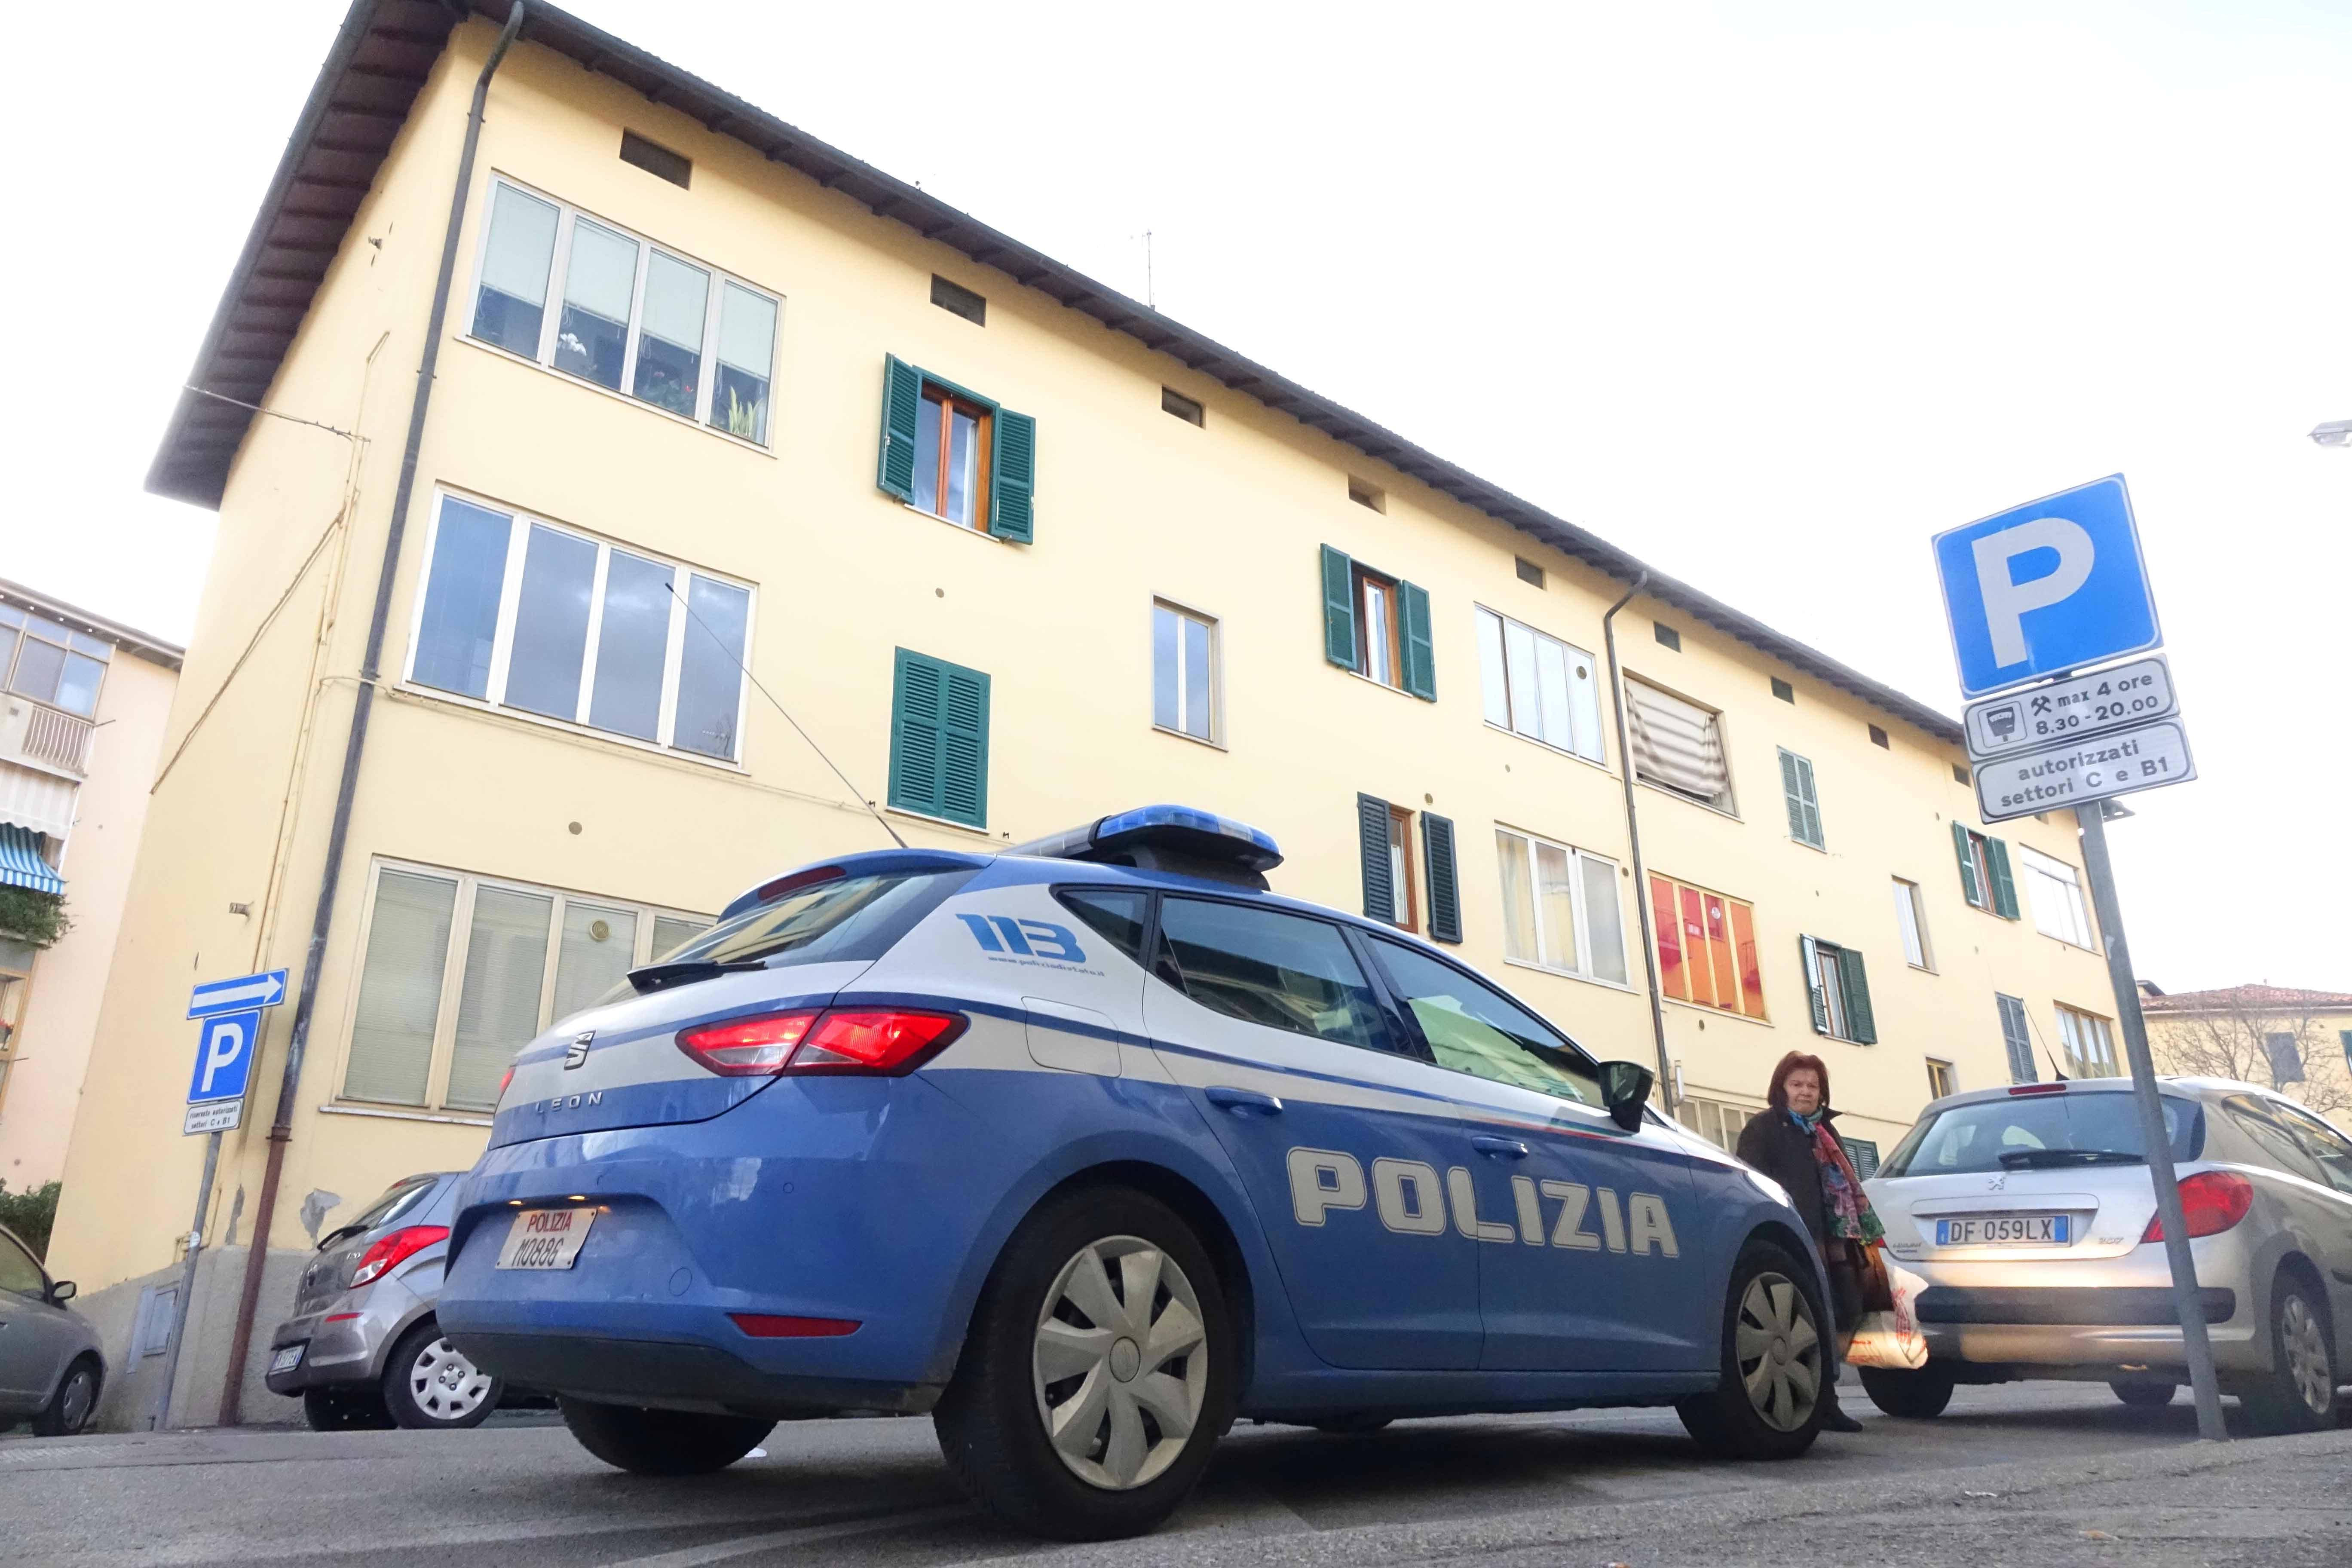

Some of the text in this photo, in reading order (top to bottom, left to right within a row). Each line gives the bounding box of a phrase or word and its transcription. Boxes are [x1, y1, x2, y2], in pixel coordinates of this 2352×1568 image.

[1971, 518, 2095, 669] P
[2058, 675, 2152, 707] max 4 ore
[2036, 715, 2079, 735] 8.30
[2095, 696, 2158, 721] 20.00
[2018, 739, 2139, 781] autorizzati
[2001, 756, 2168, 807] settori C e B1
[955, 913, 1086, 963] 113
[201, 1023, 243, 1093] P
[223, 1117, 231, 1125] B1
[536, 1092, 602, 1113] LEON
[527, 1211, 573, 1233] POLIZIA
[1286, 1146, 1678, 1258] POLIZIA
[1951, 1219, 2052, 1241] DF 059LX
